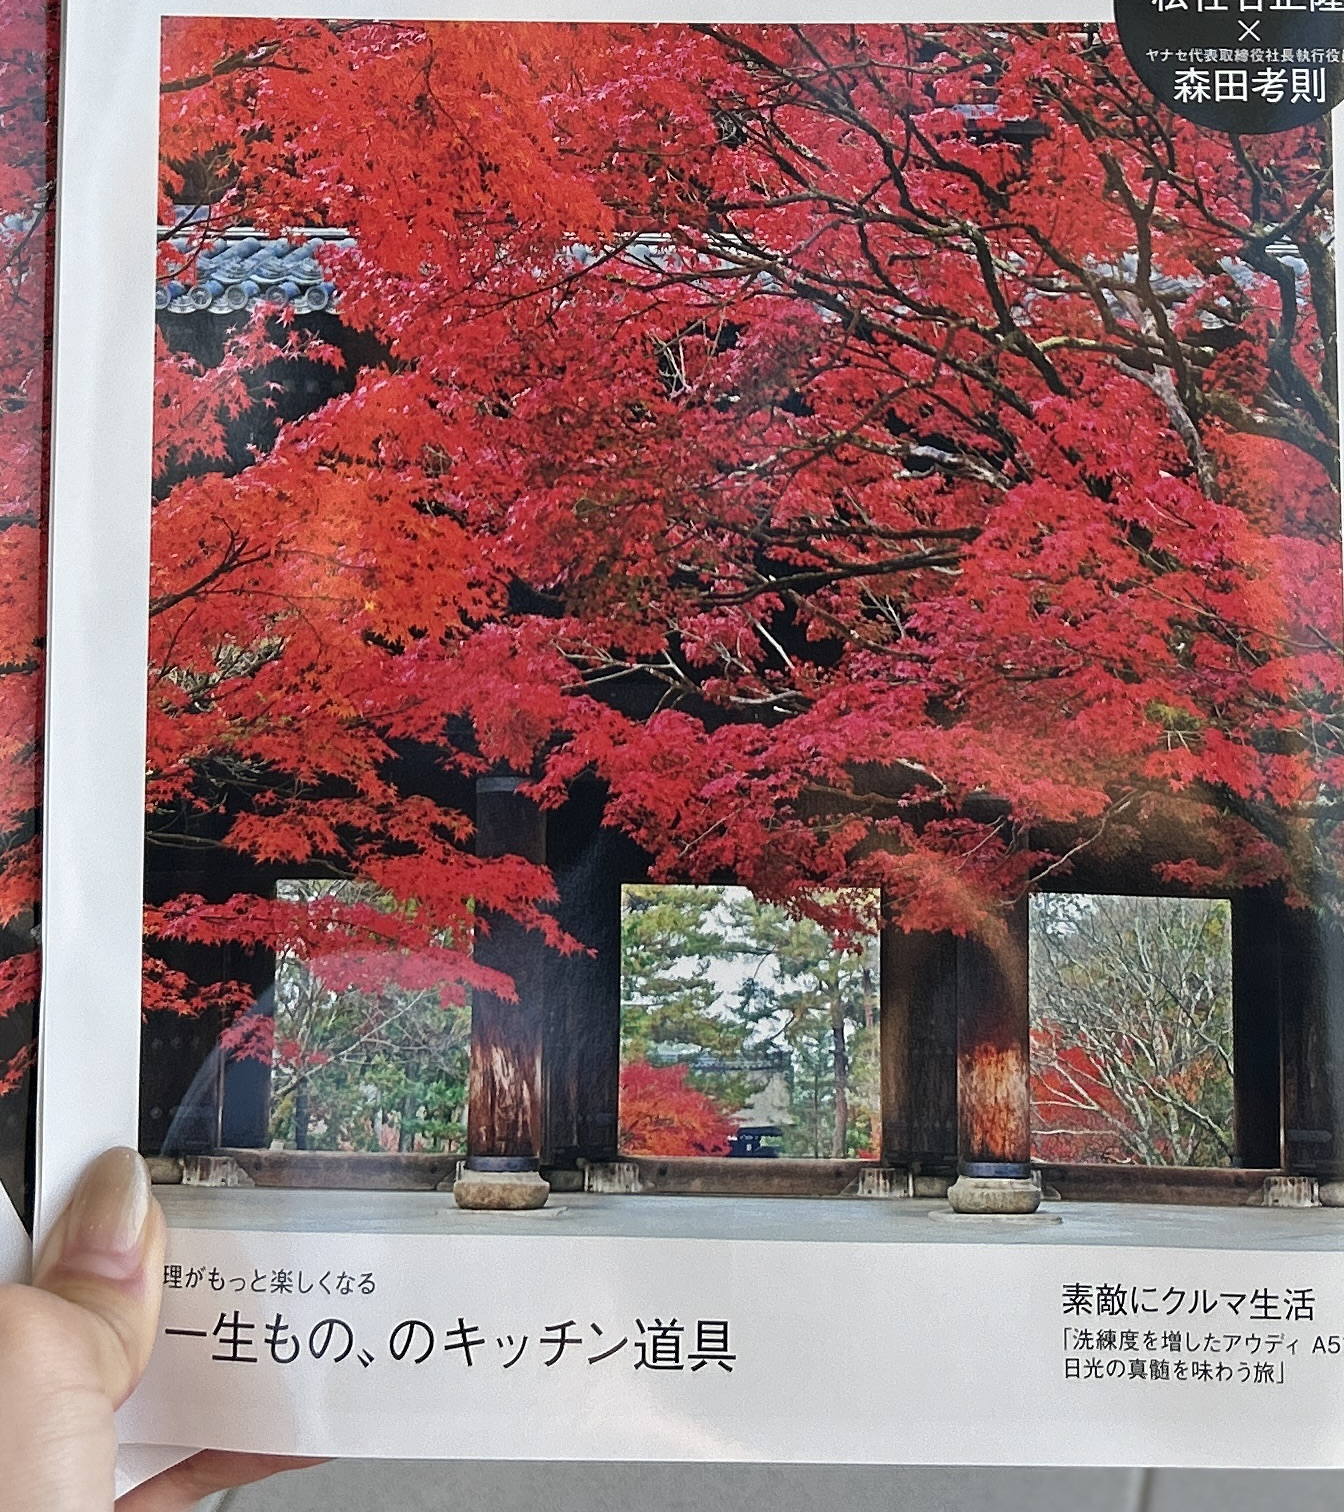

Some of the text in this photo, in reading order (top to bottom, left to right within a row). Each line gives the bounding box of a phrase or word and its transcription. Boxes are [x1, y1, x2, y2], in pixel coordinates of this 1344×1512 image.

[1173, 66, 1327, 104] 森田考則
[162, 1264, 377, 1296] 理がもっと楽しくなる
[1062, 1282, 1316, 1322] 素敵にクルマ生活
[1064, 1358, 1285, 1385] 日光の真髄を味わう旅」
